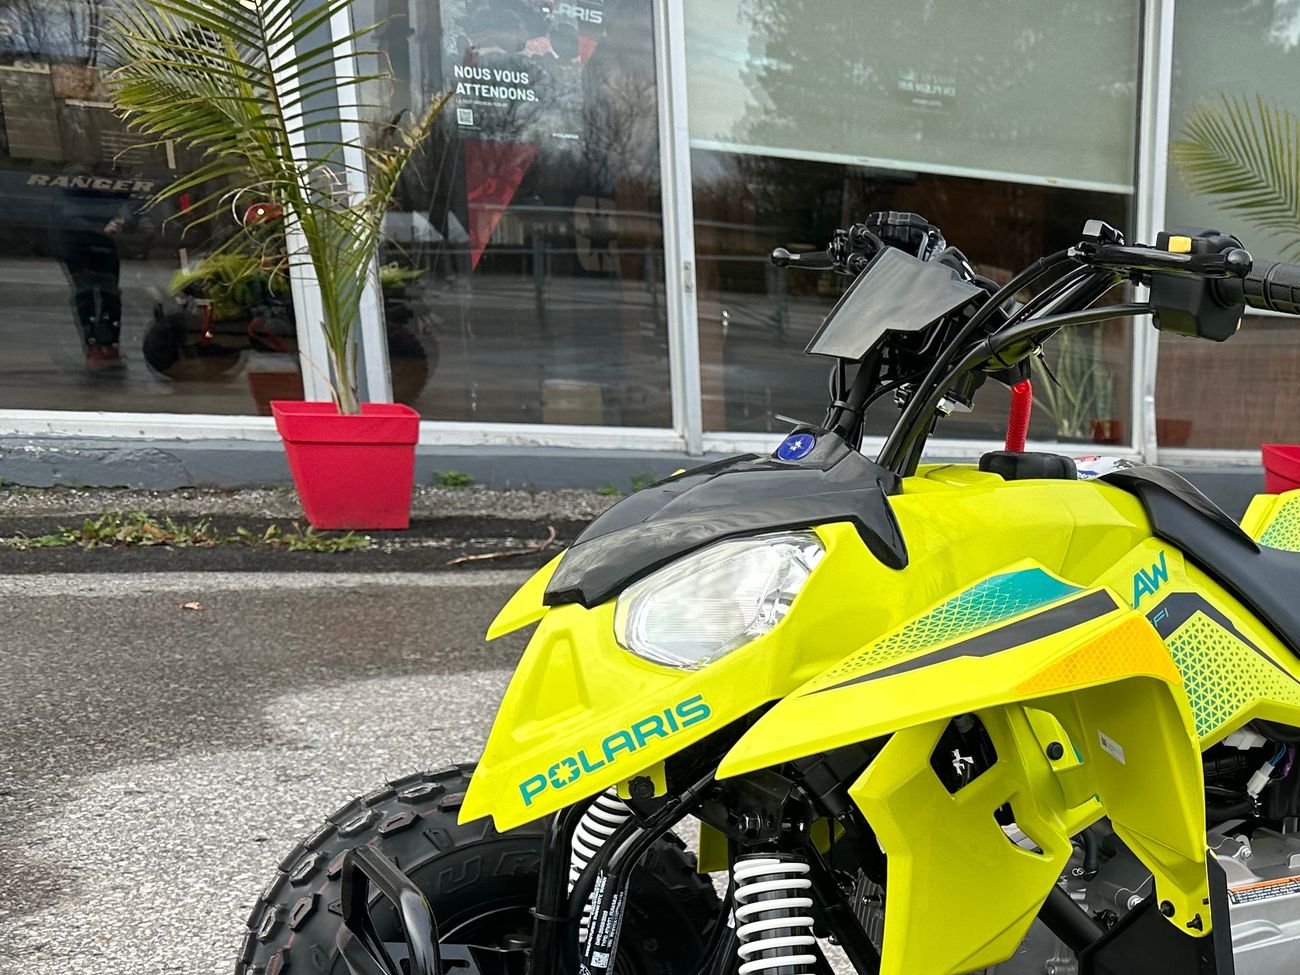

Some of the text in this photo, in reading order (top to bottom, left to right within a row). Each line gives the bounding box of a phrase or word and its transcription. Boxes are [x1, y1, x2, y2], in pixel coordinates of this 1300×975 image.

[454, 65, 529, 85] NOUS VOUS
[455, 82, 540, 102] ATTENDONS.
[27, 174, 155, 193] RANGER
[1132, 549, 1169, 610] AW
[1151, 607, 1170, 628] FI
[518, 694, 711, 807] POLARIS
